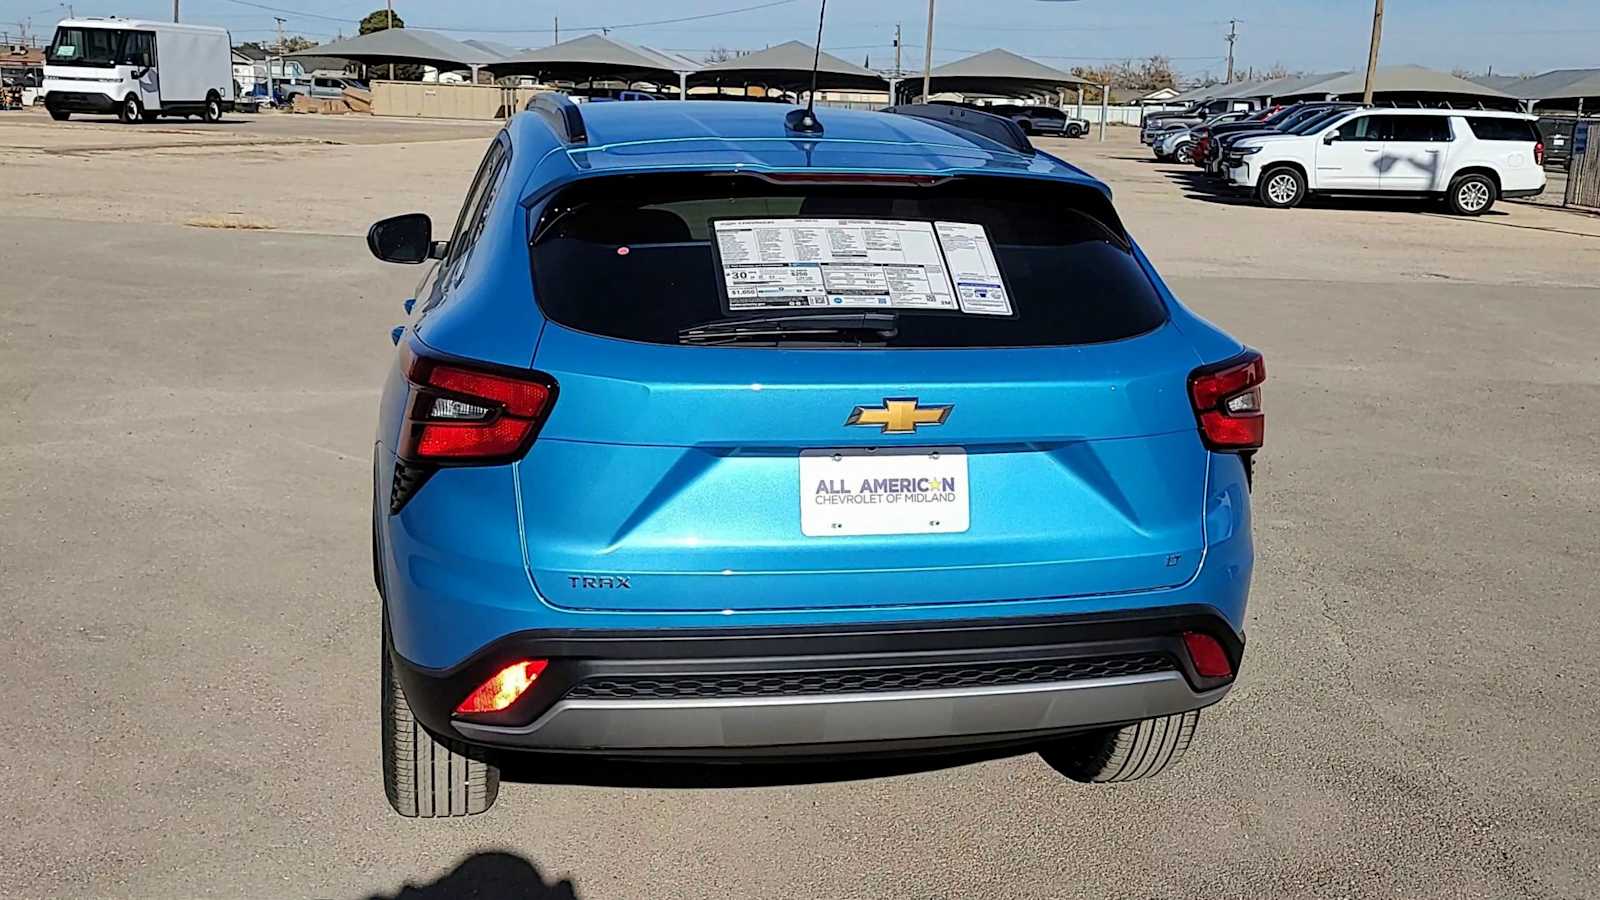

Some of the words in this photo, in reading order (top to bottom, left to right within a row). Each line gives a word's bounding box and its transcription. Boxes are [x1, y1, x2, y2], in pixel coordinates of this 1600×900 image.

[731, 271, 747, 279] 30
[815, 479, 851, 494] ALL
[859, 477, 955, 494] AMERICN
[815, 494, 884, 505] CHEVROLET
[886, 493, 903, 504] OF
[904, 492, 956, 503] MIDLAND
[567, 575, 632, 588] TRAX
